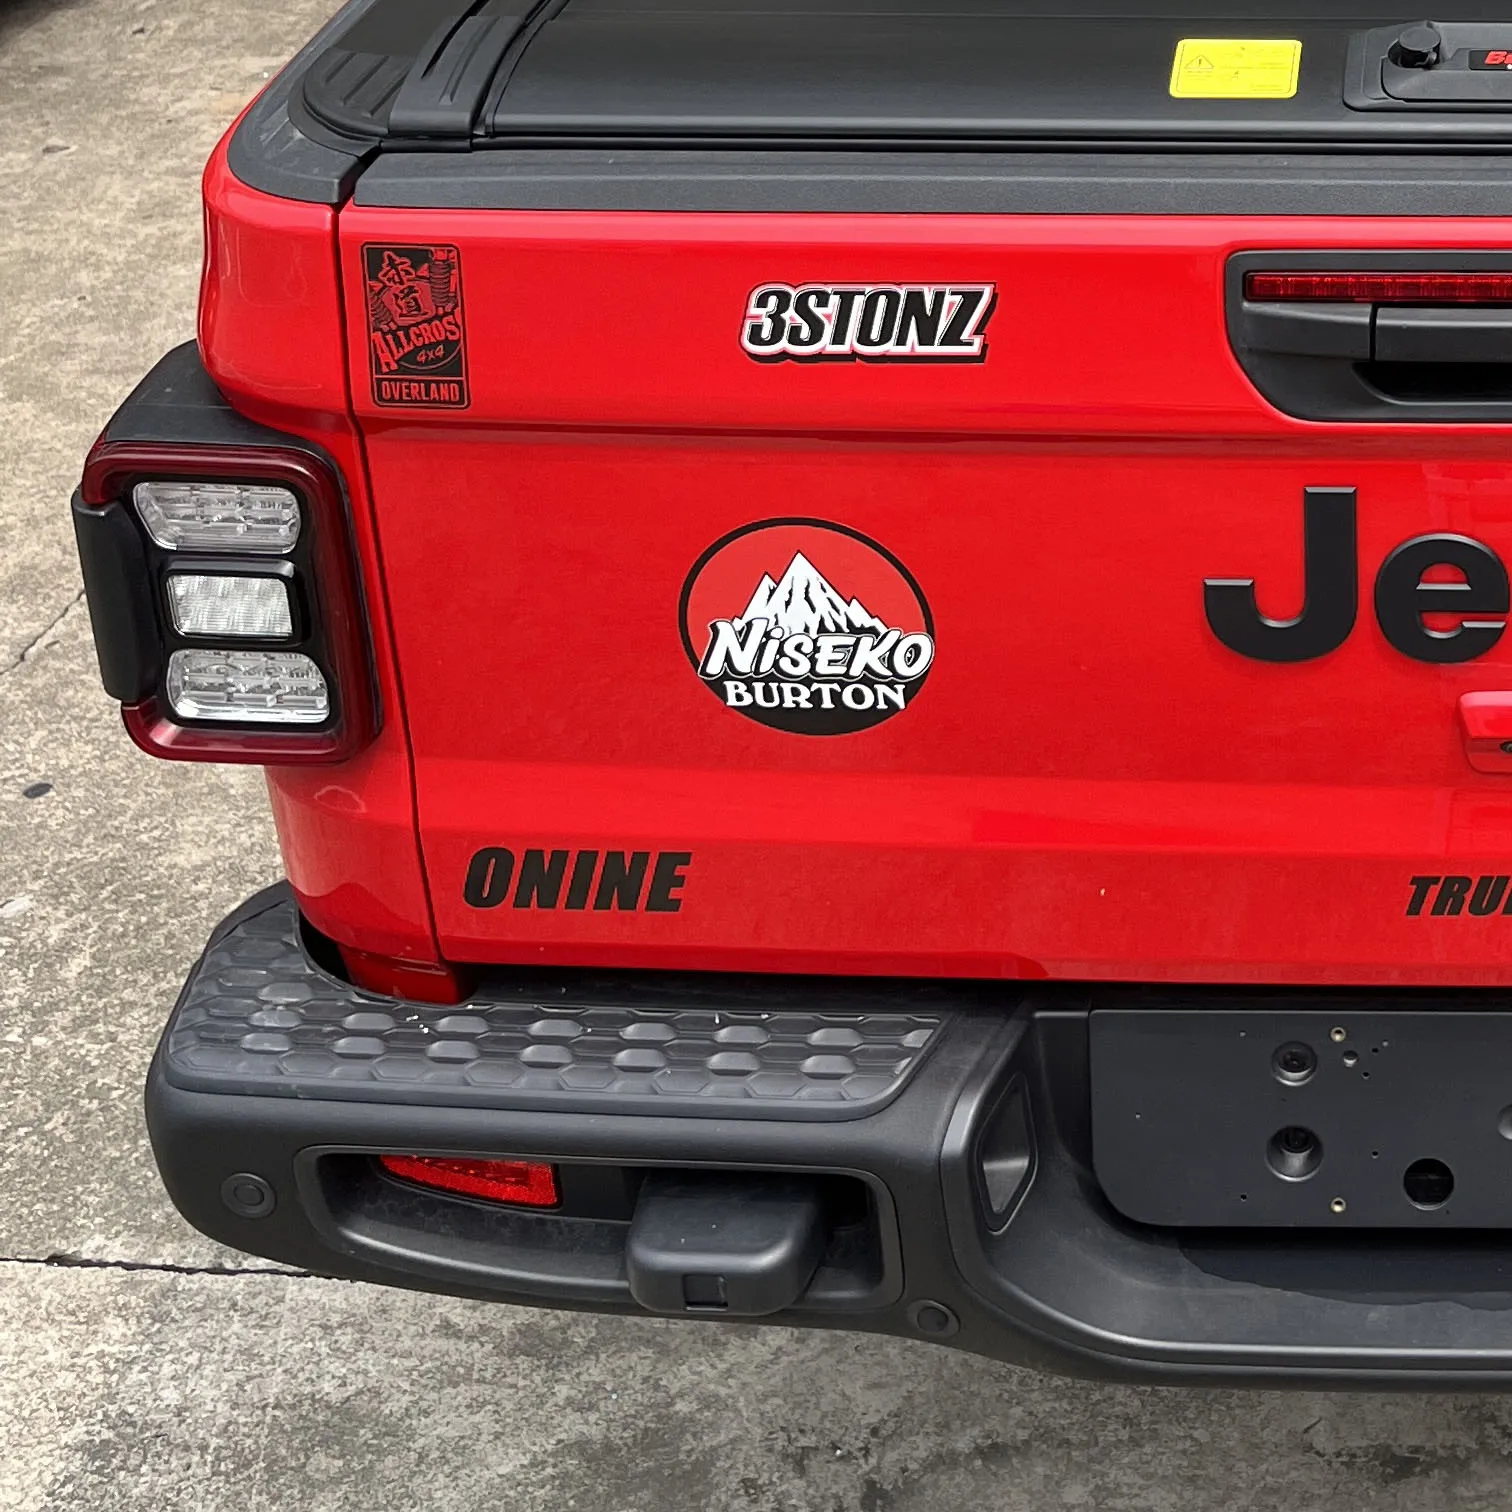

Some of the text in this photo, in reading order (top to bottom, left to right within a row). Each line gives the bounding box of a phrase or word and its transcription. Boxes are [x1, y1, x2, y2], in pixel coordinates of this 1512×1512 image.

[742, 284, 991, 356] 3STONZ
[381, 381, 460, 402] OVERLAND
[722, 680, 907, 710] BURTON
[463, 846, 693, 912] ONINE
